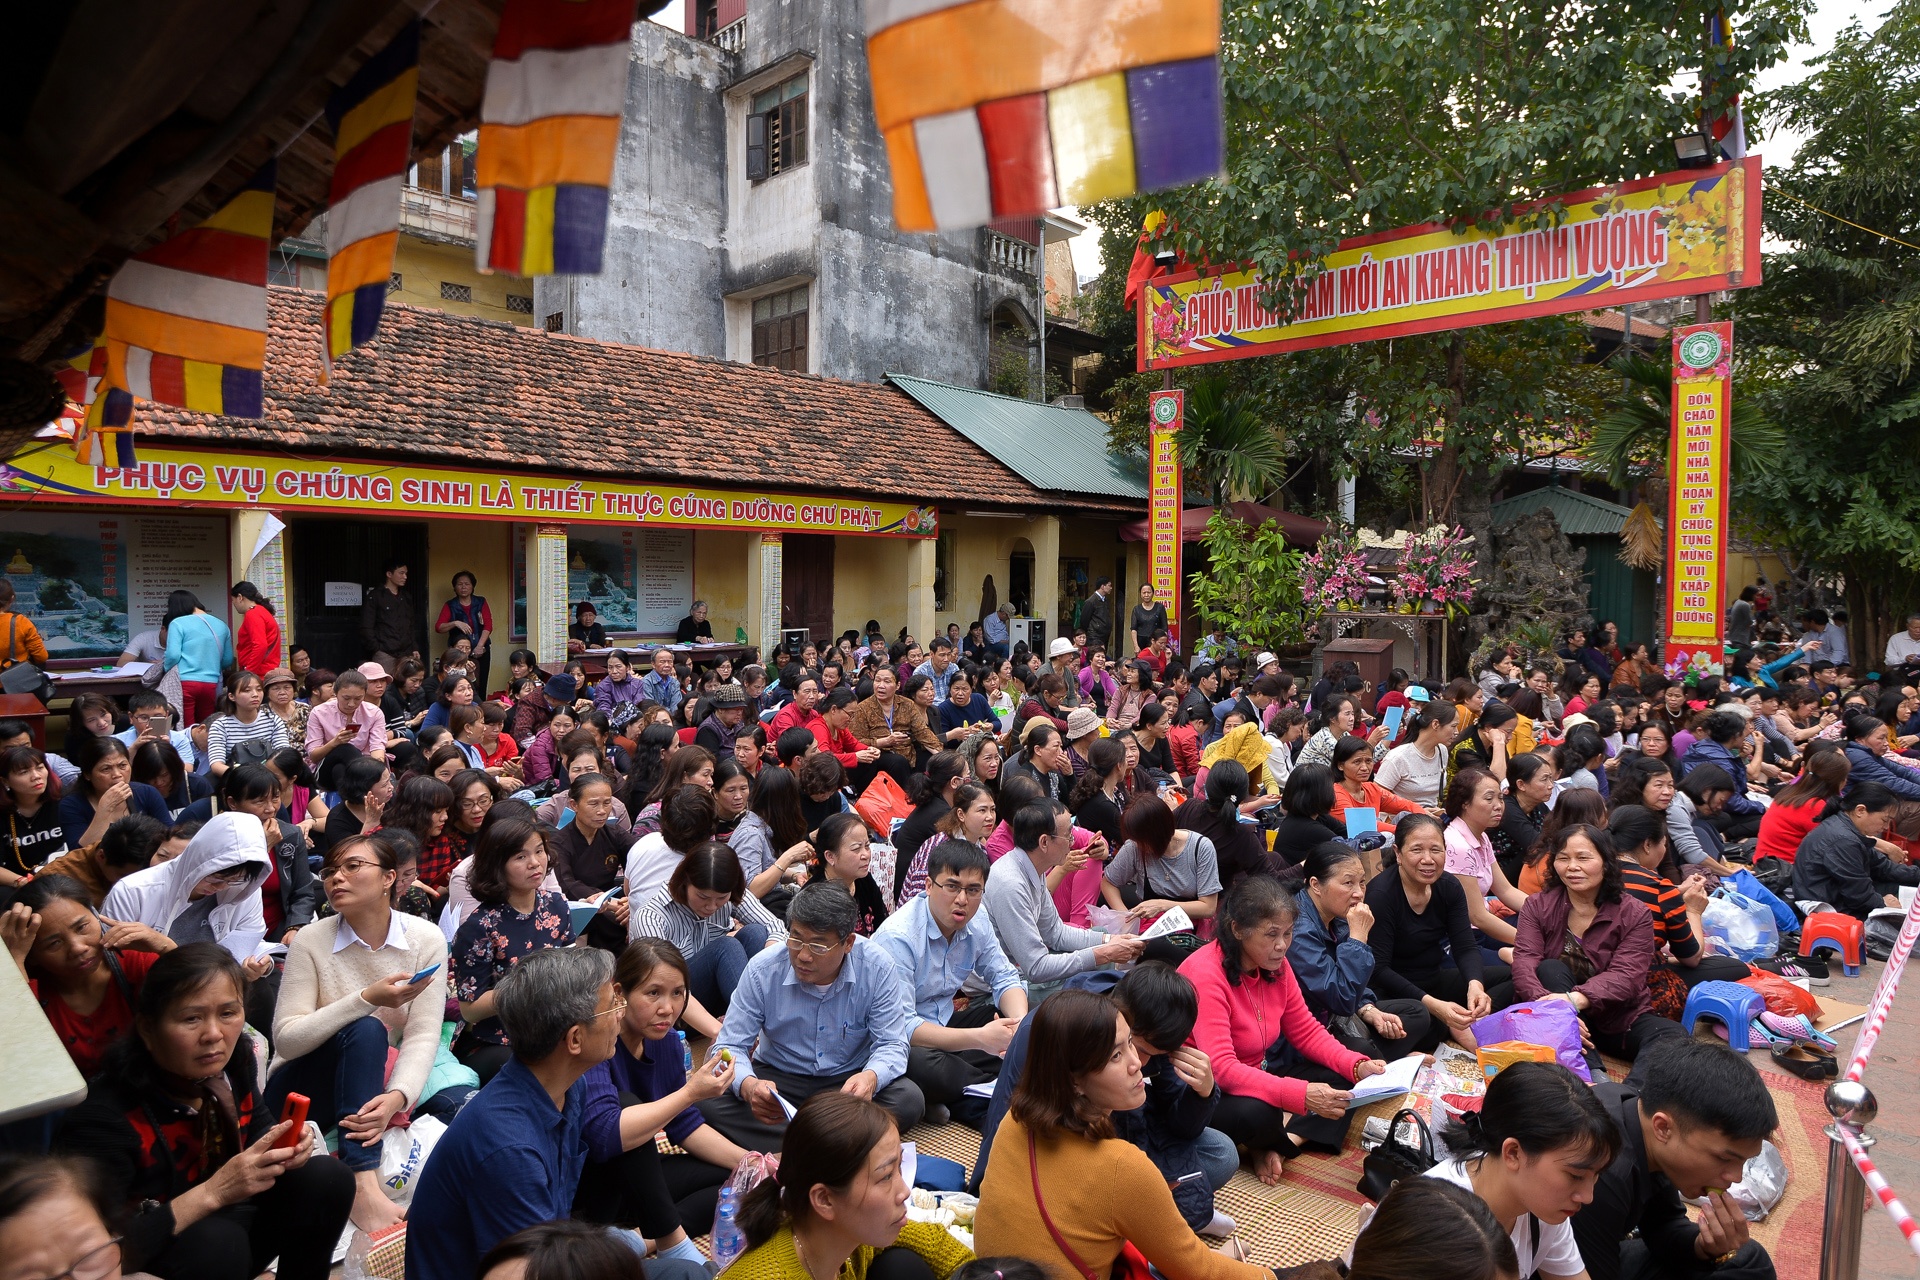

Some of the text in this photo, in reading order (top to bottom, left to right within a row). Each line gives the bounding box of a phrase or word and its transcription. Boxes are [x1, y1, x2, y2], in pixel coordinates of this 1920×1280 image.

[1187, 282, 1233, 338] CHÚC
[1338, 253, 1379, 316] MỚI
[1382, 255, 1411, 308] AN
[1414, 240, 1491, 303] KHANG
[1494, 226, 1569, 298] THỊNH
[1574, 207, 1667, 285] VƯỢNG
[1687, 393, 1711, 405] ĐÓN
[1684, 408, 1715, 421] CHÀO
[1686, 425, 1712, 436] NĂM
[1687, 440, 1710, 452] MỚI
[1686, 455, 1710, 467] NHÀ
[1156, 465, 1174, 473] XUÂN
[1686, 471, 1709, 483] NHÀ
[95, 461, 883, 531] PHỤC VỤ CHÚNG SINH LÀ THIẾT THỰC CÚNG DƯỜNG CHƯ PHẬT
[1682, 488, 1713, 499] HOAN
[1155, 522, 1173, 530] HOAN
[1681, 518, 1712, 529] CHÚC
[1155, 533, 1173, 541] CUNG
[1681, 535, 1711, 547] TỤNG
[1679, 548, 1712, 560] MỪNG
[1685, 566, 1705, 576] VUI
[1675, 610, 1713, 622] ĐƯỜNG
